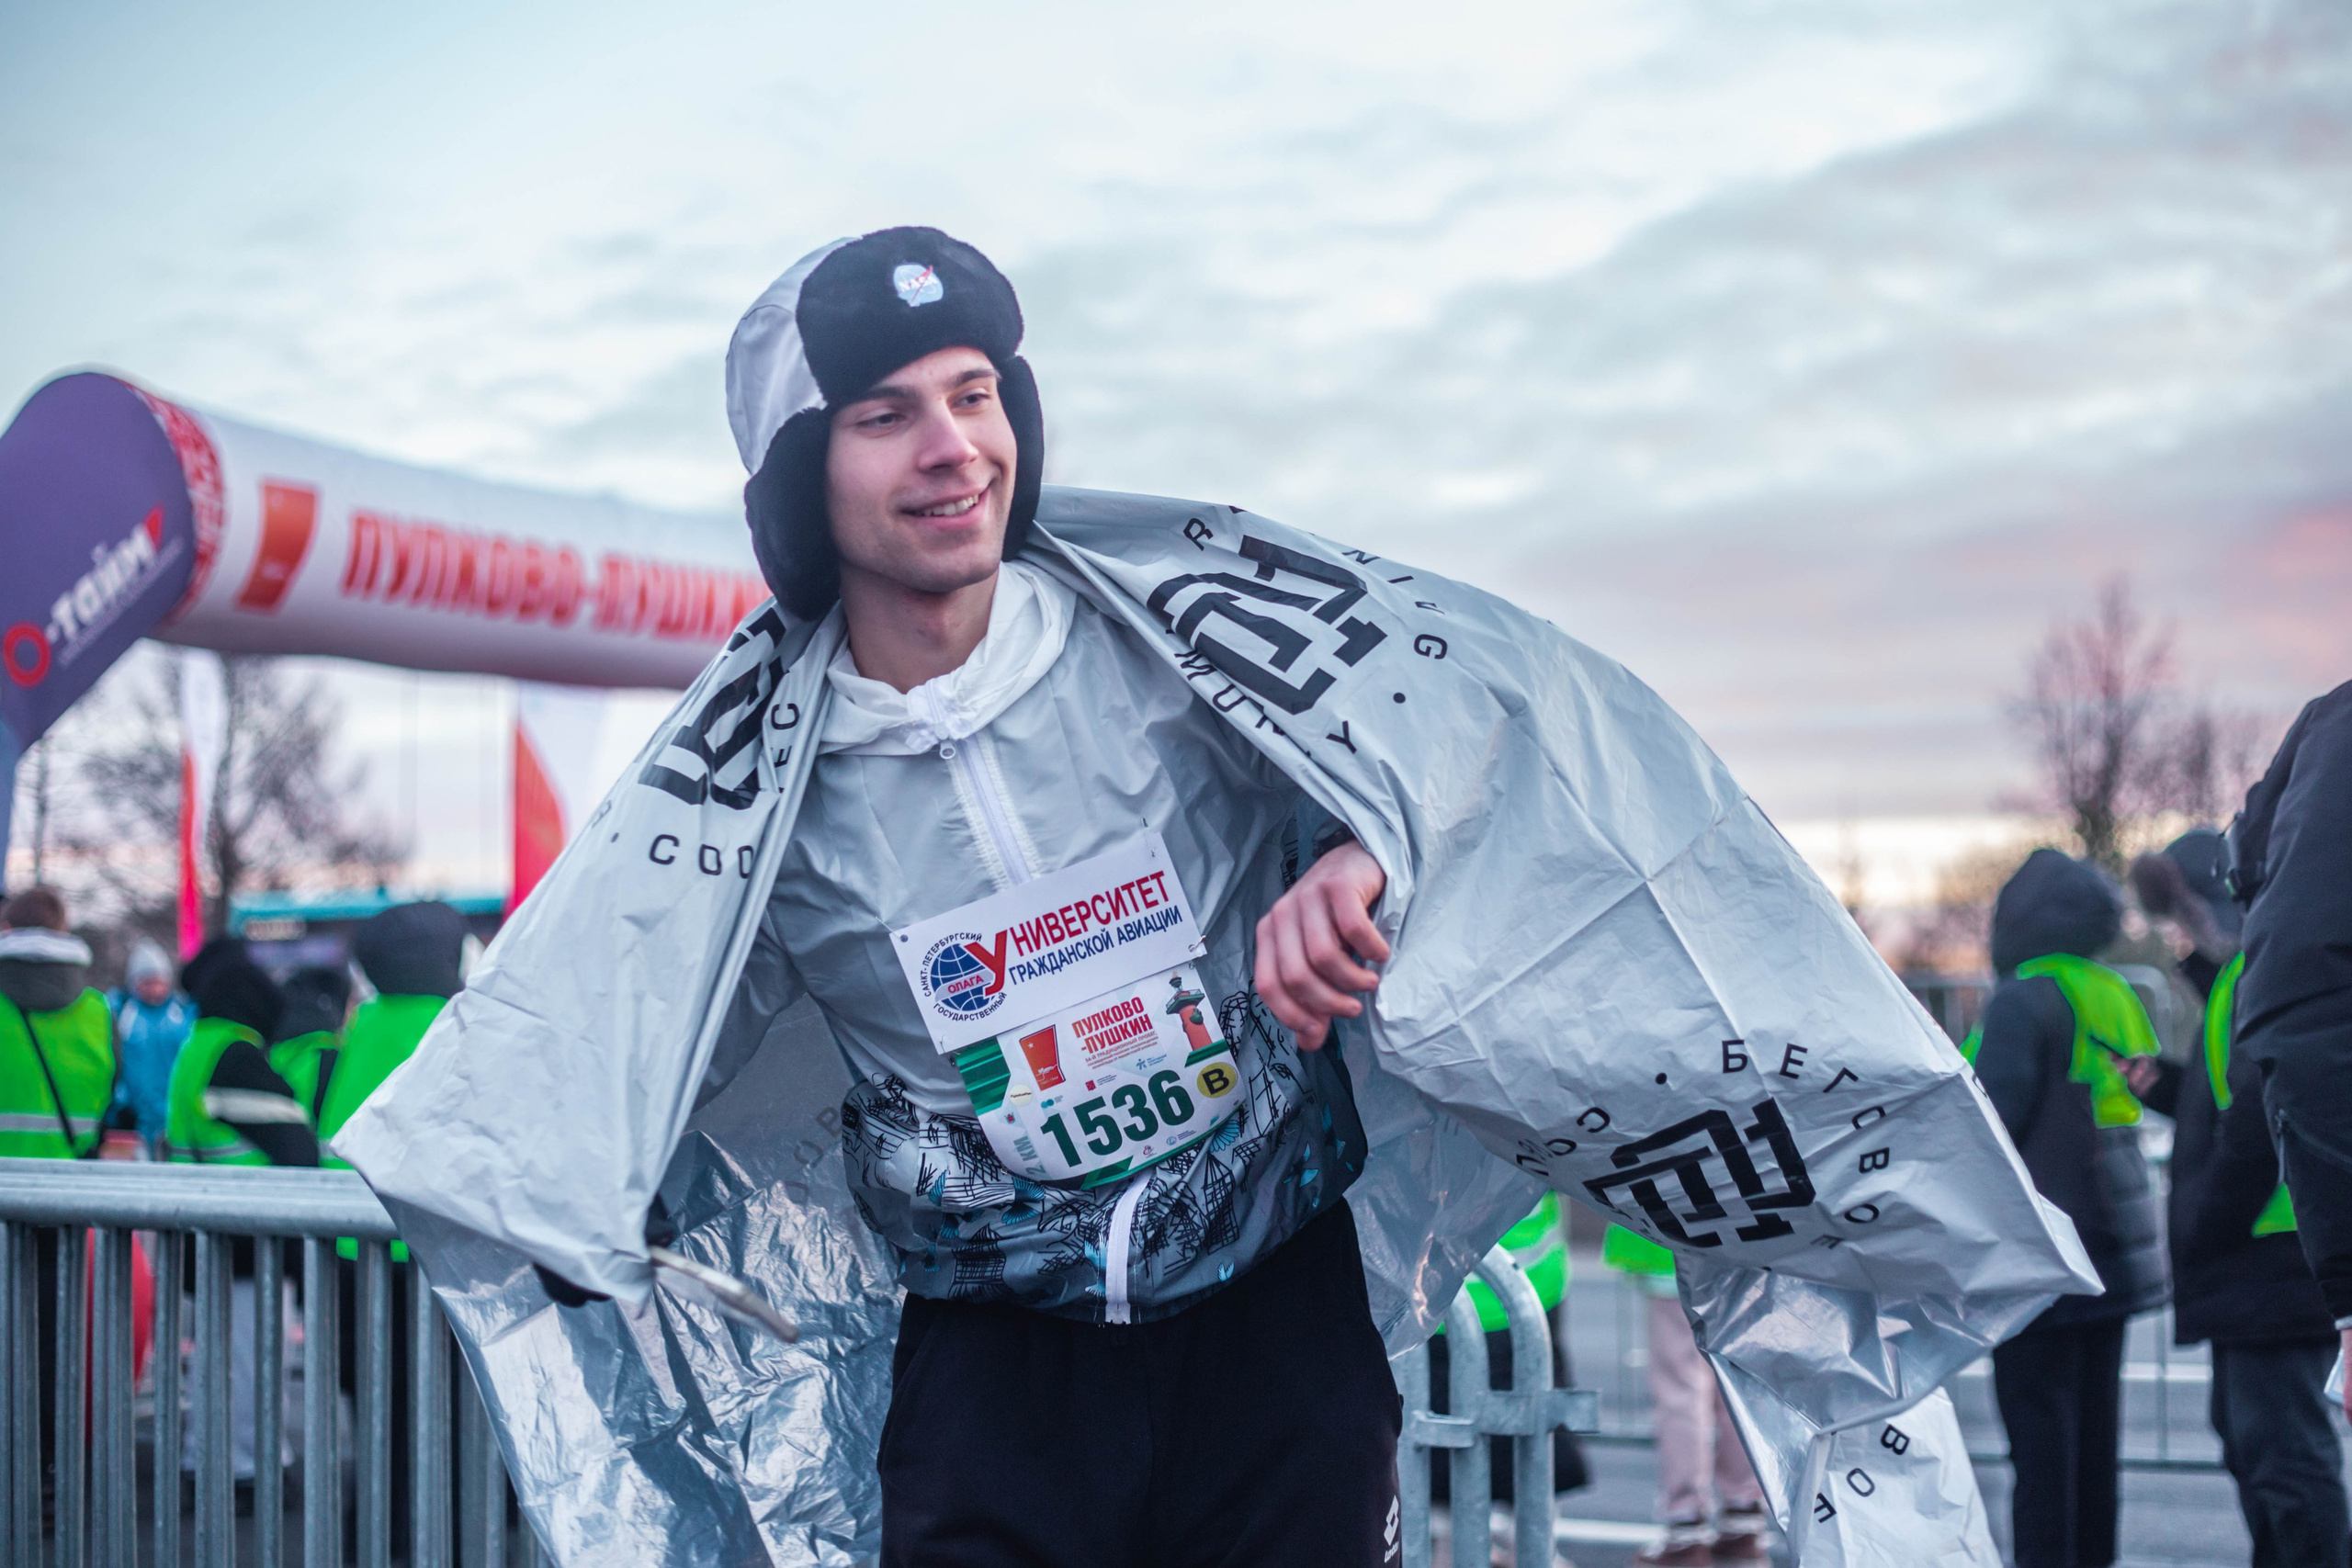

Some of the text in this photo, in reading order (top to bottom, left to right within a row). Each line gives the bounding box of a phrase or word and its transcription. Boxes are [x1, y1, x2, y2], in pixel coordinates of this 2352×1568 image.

[899, 275, 938, 292] NASA
[1009, 905, 1182, 985] ГРАЖДАНСКОЙ АВИАЦИИ
[947, 975, 984, 994] ОЛАГА
[933, 991, 1008, 1021] ГОСУДАРСТВЕННЫЙ
[1071, 997, 1145, 1039] ПУЛКОВО
[1081, 1013, 1153, 1055] -ПУШКИН
[1040, 1069, 1195, 1168] 1536
